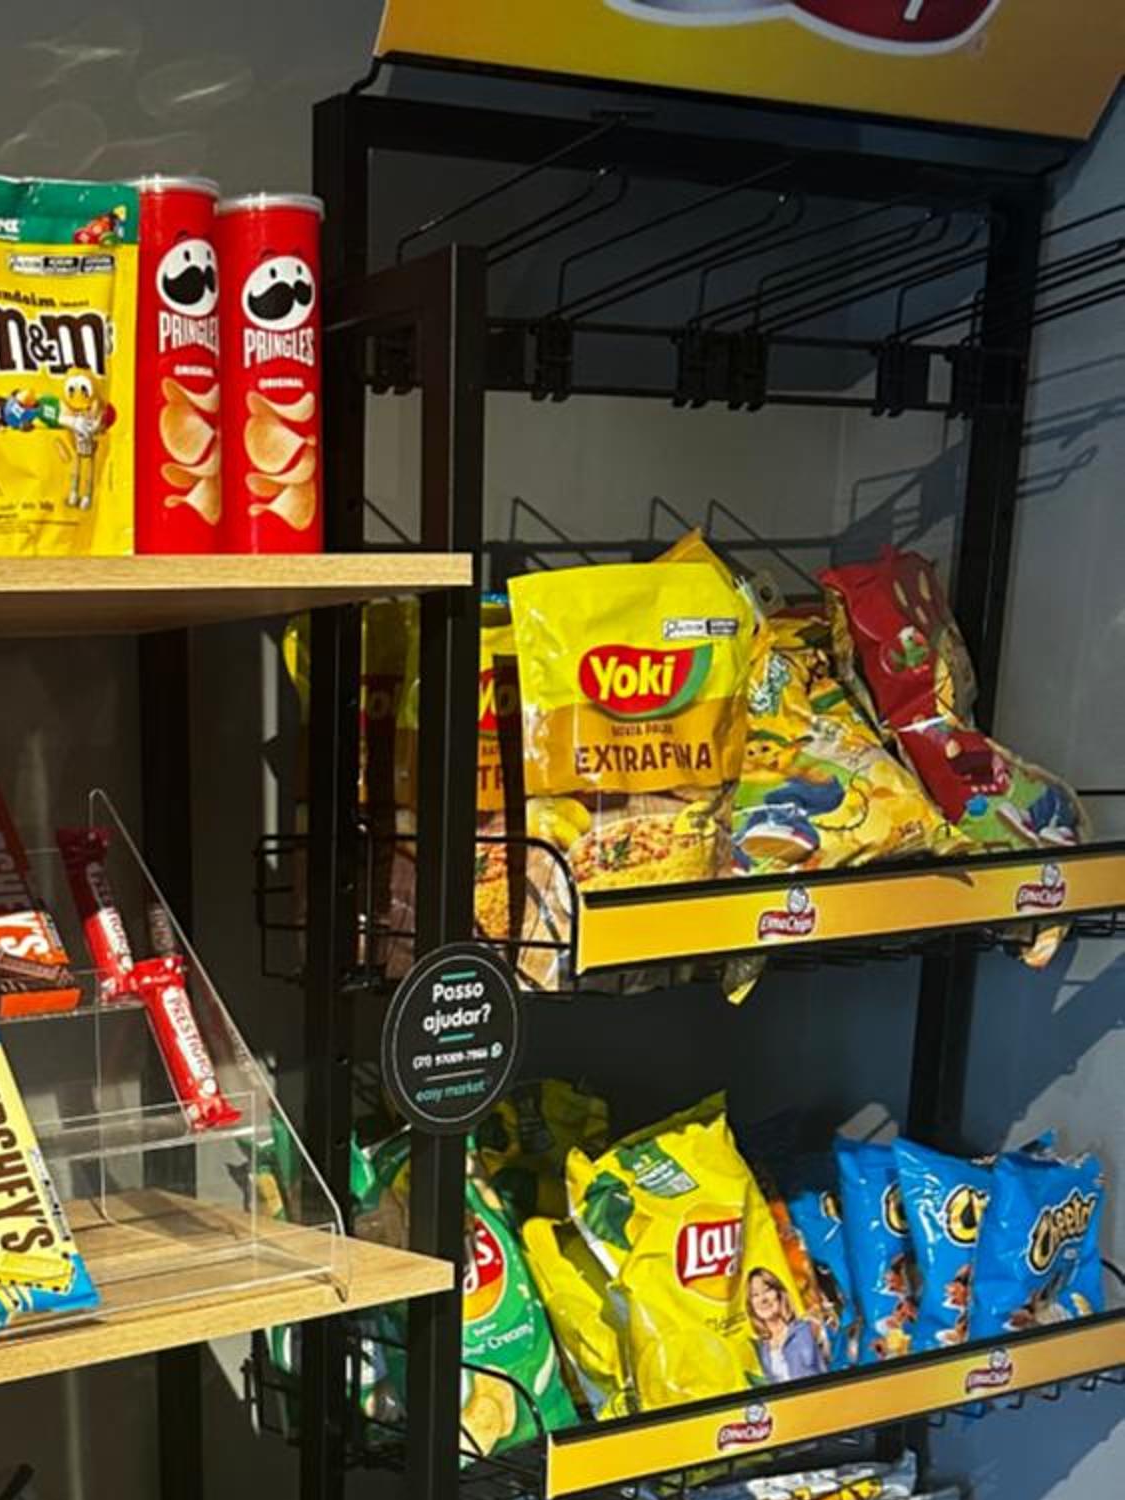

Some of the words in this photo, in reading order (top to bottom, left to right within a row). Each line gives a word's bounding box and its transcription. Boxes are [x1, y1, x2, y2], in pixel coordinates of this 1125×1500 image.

[242, 326, 316, 370] PRINGLES
[588, 655, 677, 701] Yoki
[431, 981, 485, 1004] Posso
[422, 1002, 492, 1036] ajudar?
